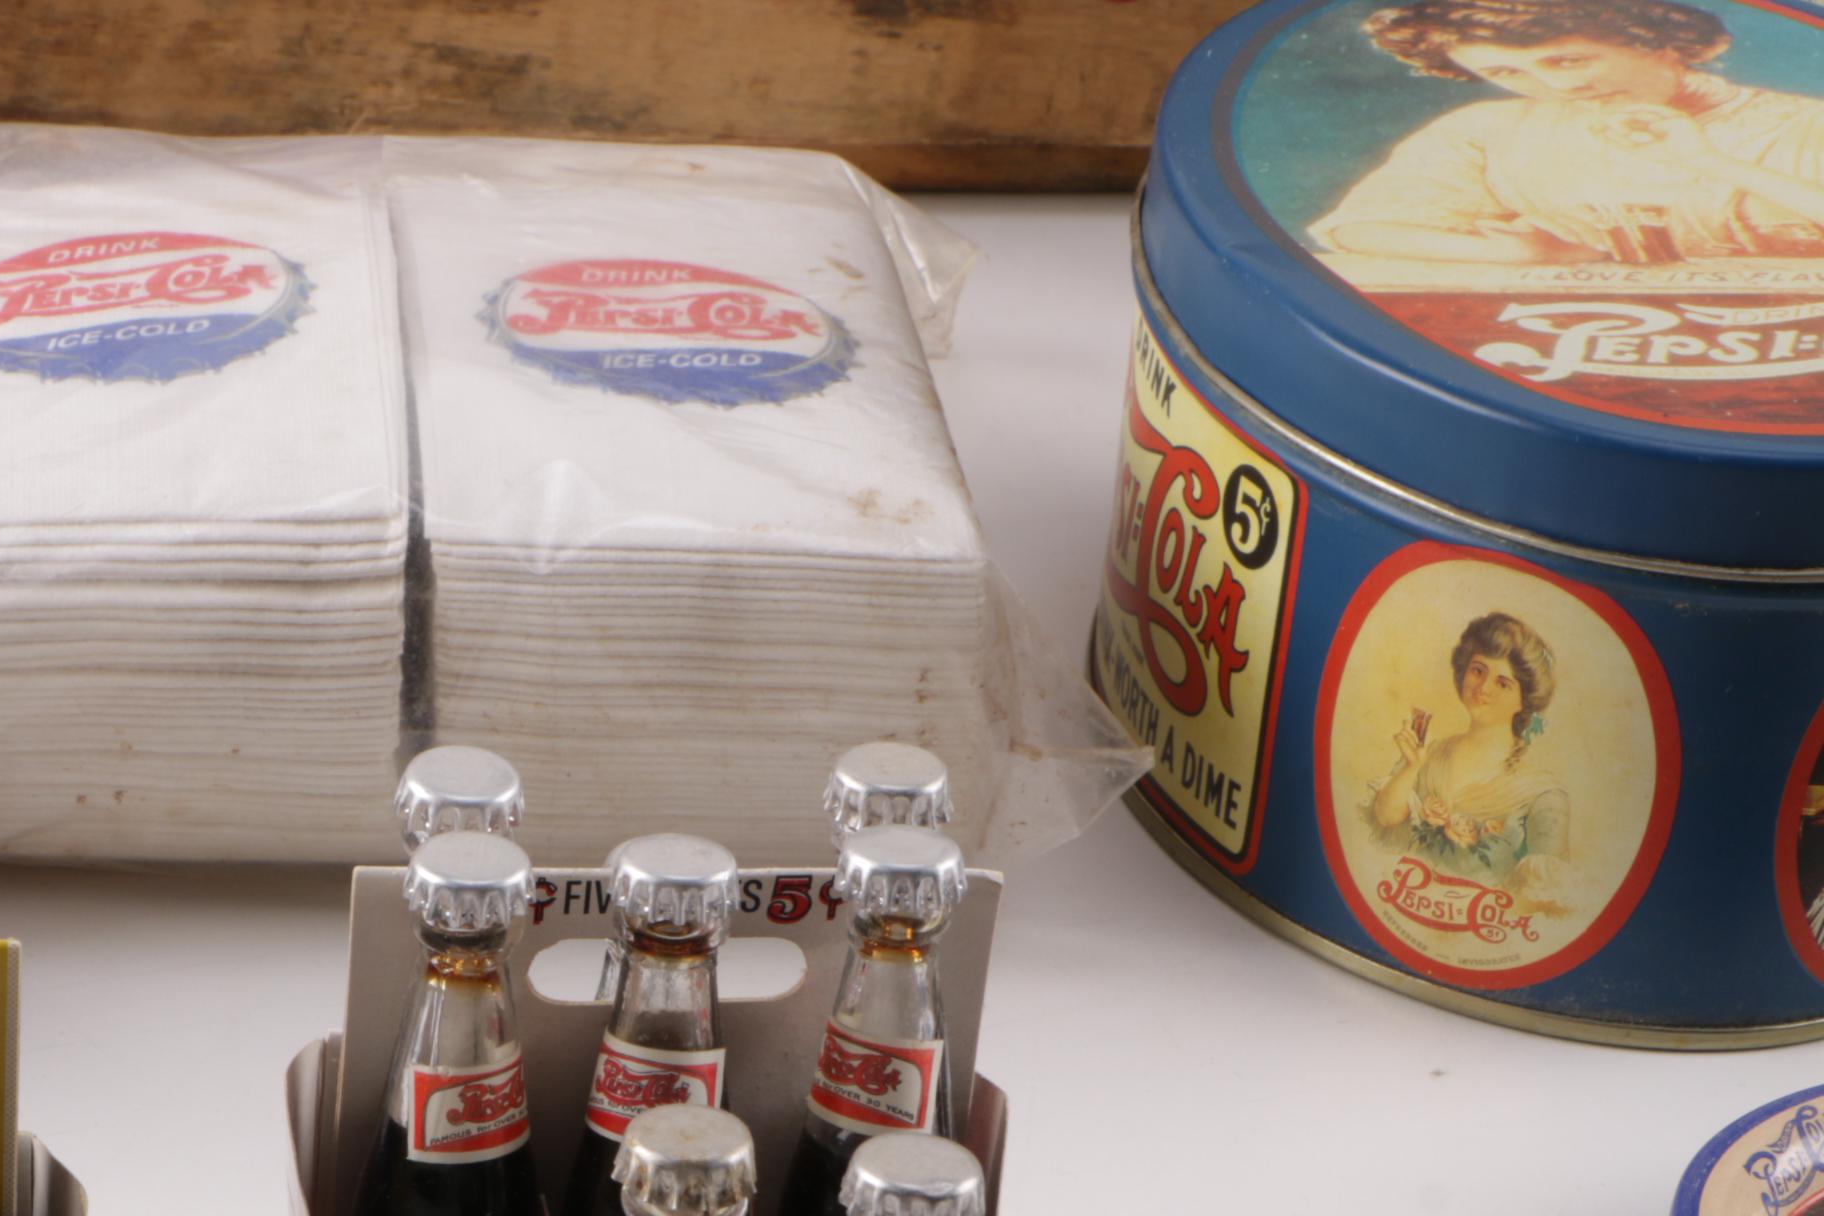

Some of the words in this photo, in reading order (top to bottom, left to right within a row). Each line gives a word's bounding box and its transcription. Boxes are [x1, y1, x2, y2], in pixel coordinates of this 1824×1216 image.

[47, 236, 160, 264] DRINK
[581, 267, 692, 284] DRINK
[46, 318, 211, 351] ICE-COLD
[603, 350, 763, 369] ICE-COLD
[1161, 724, 1174, 774] A
[1181, 740, 1242, 830] DIME
[834, 1085, 861, 1101] OVER
[430, 1128, 472, 1145] FAMOUS
